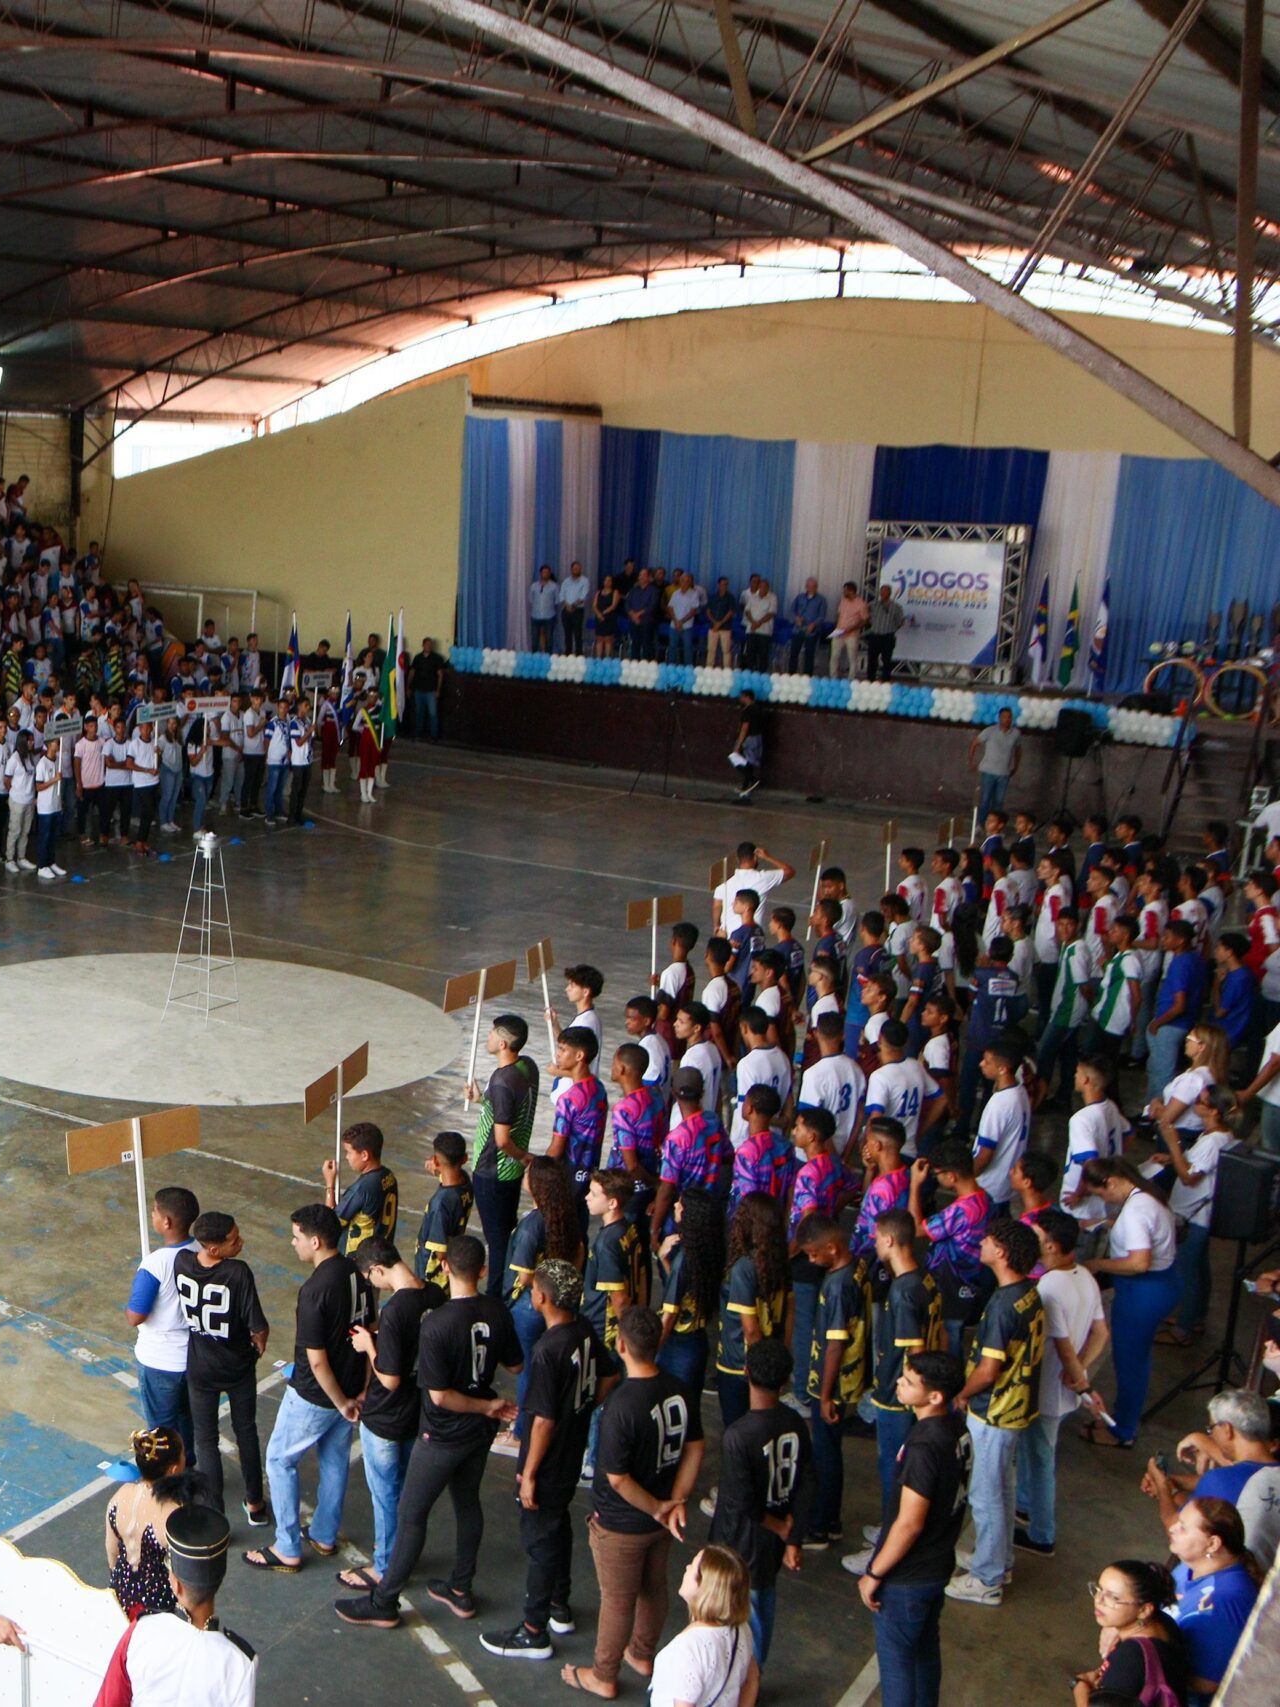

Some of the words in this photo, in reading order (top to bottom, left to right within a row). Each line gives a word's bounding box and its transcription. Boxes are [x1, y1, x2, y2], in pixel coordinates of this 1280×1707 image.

[908, 568, 990, 591] JOGOS
[908, 588, 988, 602] ESCOLARES
[896, 1087, 919, 1117] 14
[177, 1274, 231, 1338] 22
[471, 1321, 490, 1382] 6
[571, 1336, 597, 1410] 14
[650, 1394, 688, 1470] 19
[762, 1432, 799, 1502] 18
